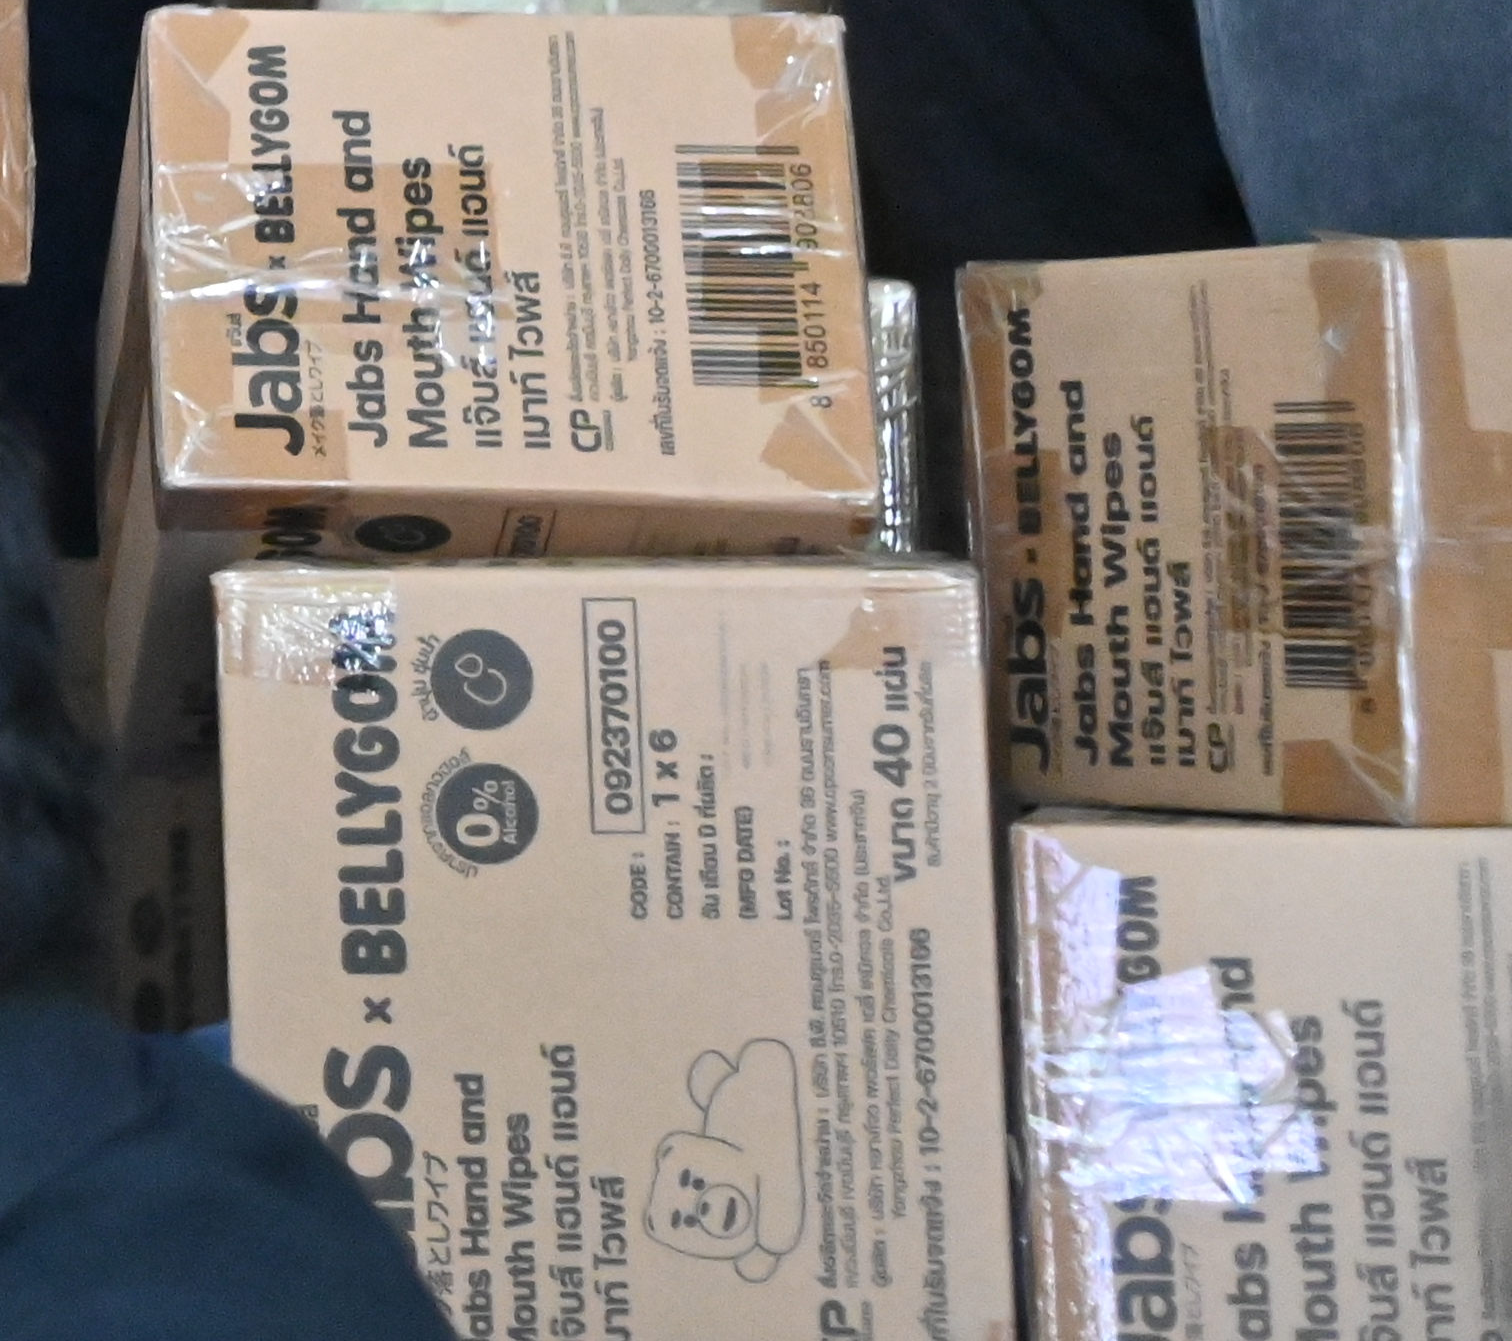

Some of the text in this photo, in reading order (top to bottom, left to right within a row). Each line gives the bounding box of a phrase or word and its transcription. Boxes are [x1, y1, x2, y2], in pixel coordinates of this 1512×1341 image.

[247, 45, 295, 243] BELLYGOM
[448, 144, 489, 236] แอนด์
[332, 111, 388, 448] Jabs Hand and
[395, 158, 448, 448] Mouth Wipes
[639, 189, 665, 324] 10-2-6700013166
[227, 277, 305, 456] Jabs
[792, 282, 833, 409] 8 850114
[509, 371, 551, 449] เมาท์
[570, 409, 601, 452] CP
[1060, 381, 1098, 766] Jabs Hand and
[1100, 432, 1133, 767] Mouth Wipes
[649, 728, 677, 753] 6
[1007, 579, 1050, 775] Jabs
[598, 619, 648, 920] CODE 092370100
[652, 793, 680, 807] 1
[872, 723, 913, 788] 40
[1207, 722, 1232, 773] CP
[501, 780, 517, 844] Alcohol
[889, 797, 918, 882] ขนาด
[665, 832, 684, 920] CONTAIN
[910, 928, 941, 1154] 10-2-6700013166
[454, 1073, 492, 1256] Hand and
[502, 1112, 540, 1227] Wipes
[542, 1043, 583, 1252] แฮนด์ แอนด์
[590, 1175, 628, 1270] ไวพส์
